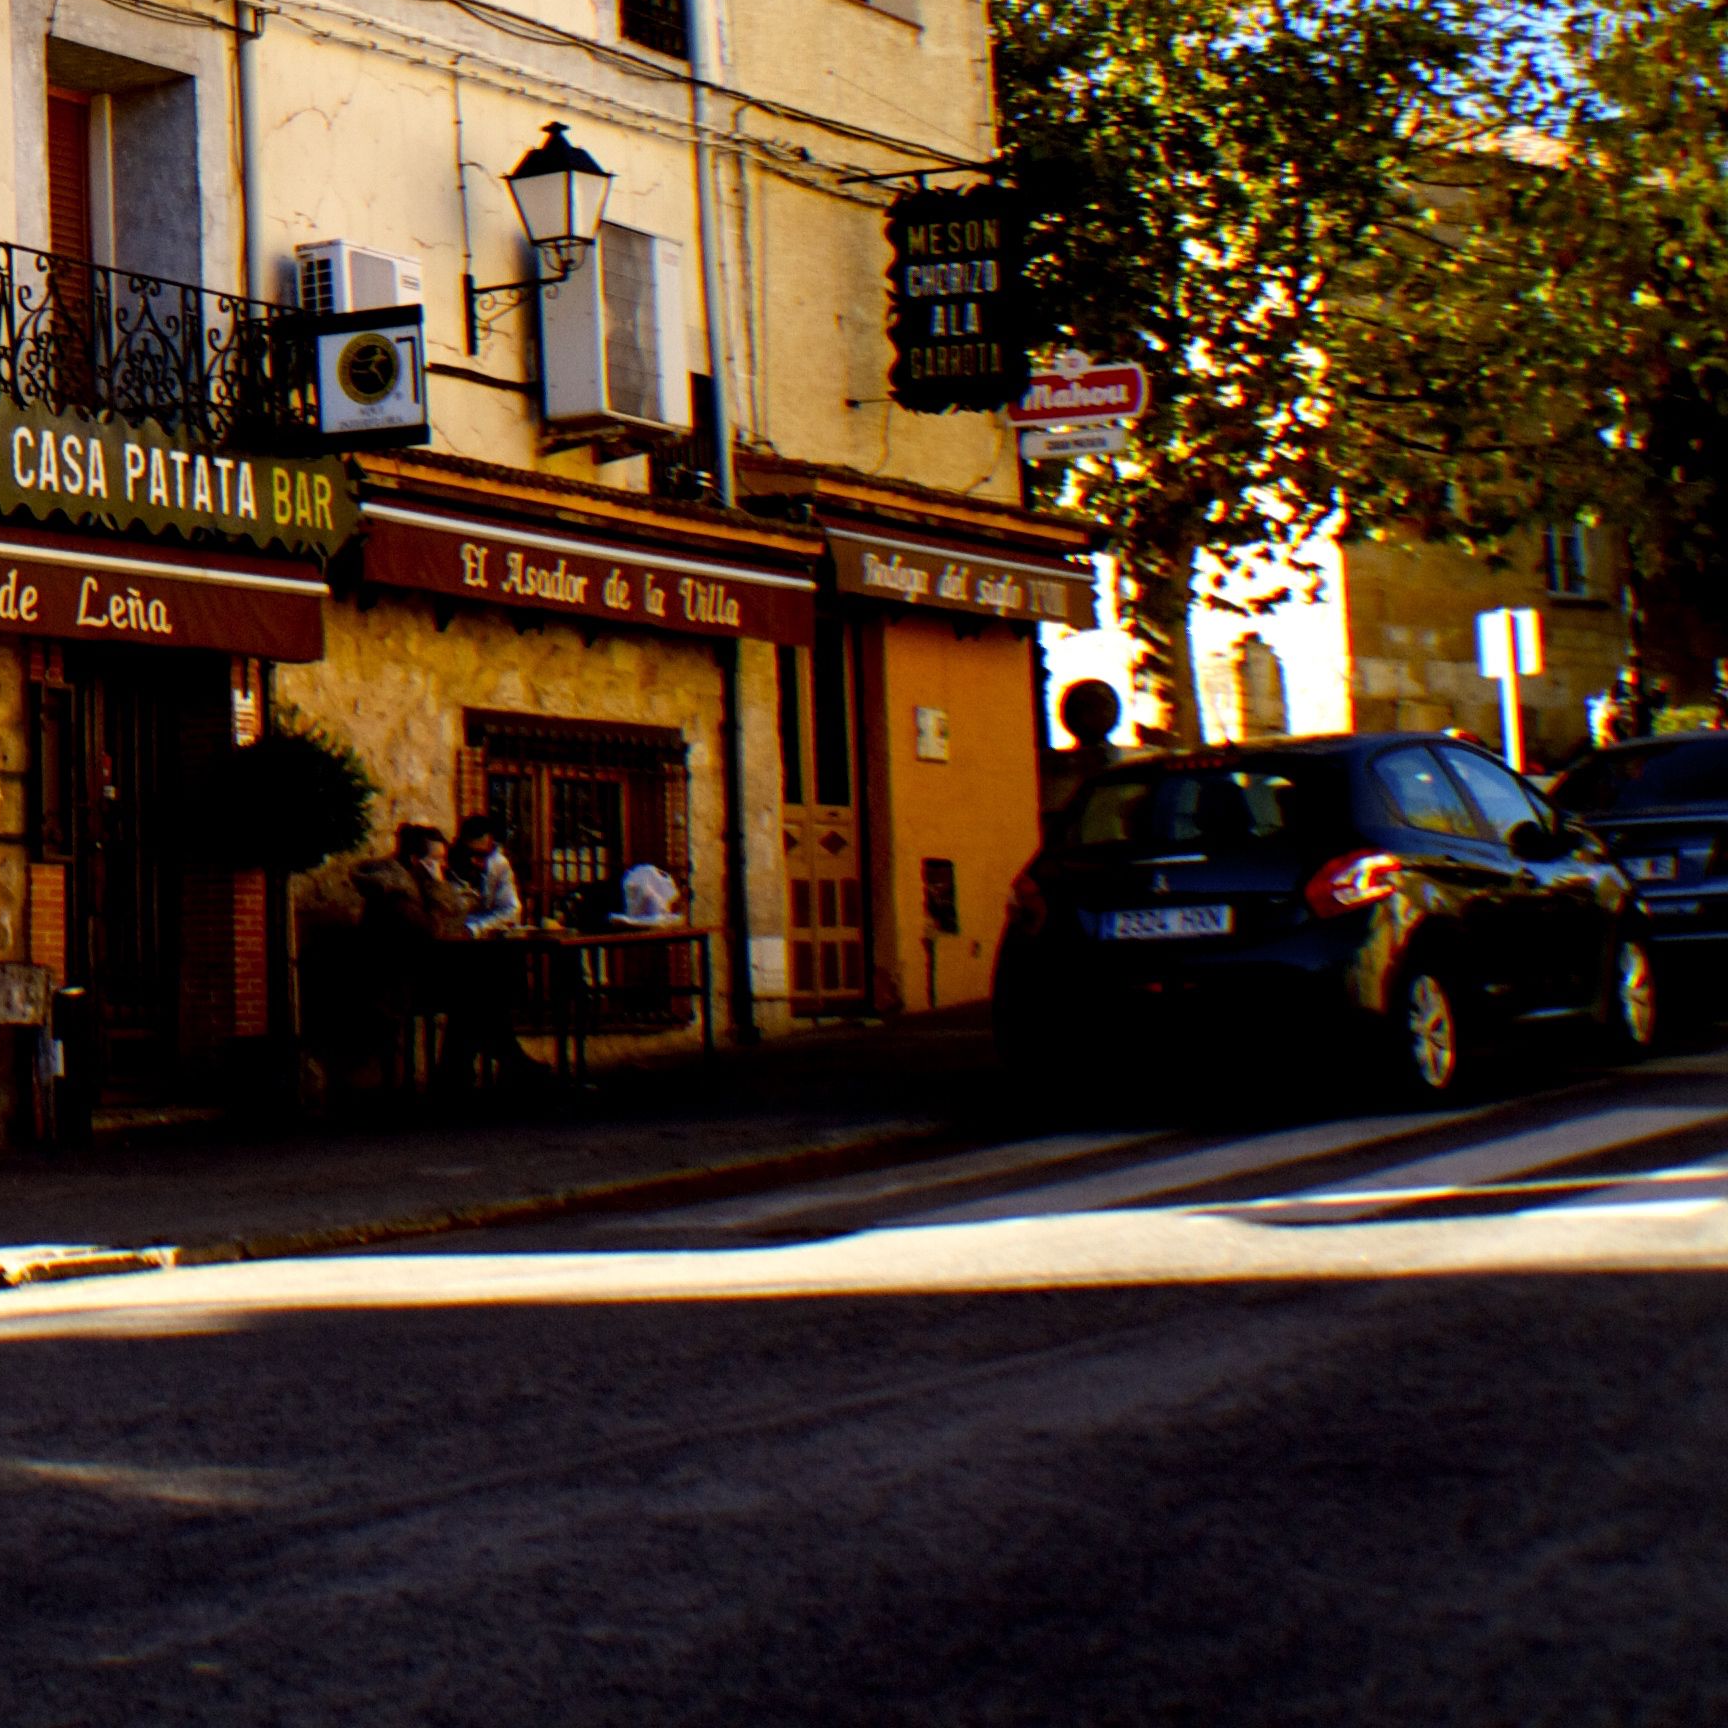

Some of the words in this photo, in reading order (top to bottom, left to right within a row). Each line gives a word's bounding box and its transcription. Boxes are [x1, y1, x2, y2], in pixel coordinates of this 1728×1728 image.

[907, 219, 1000, 256] MESON
[906, 259, 999, 298] CHORIZO
[1021, 379, 1130, 412] Mahou
[12, 426, 109, 500] CASA
[124, 443, 258, 521] PATATA
[273, 467, 334, 530] BAR
[76, 575, 173, 635] Leña
[461, 543, 489, 589] El
[501, 552, 589, 604] Asador
[603, 568, 631, 611] de
[645, 573, 666, 618] la
[679, 577, 740, 628] Villa
